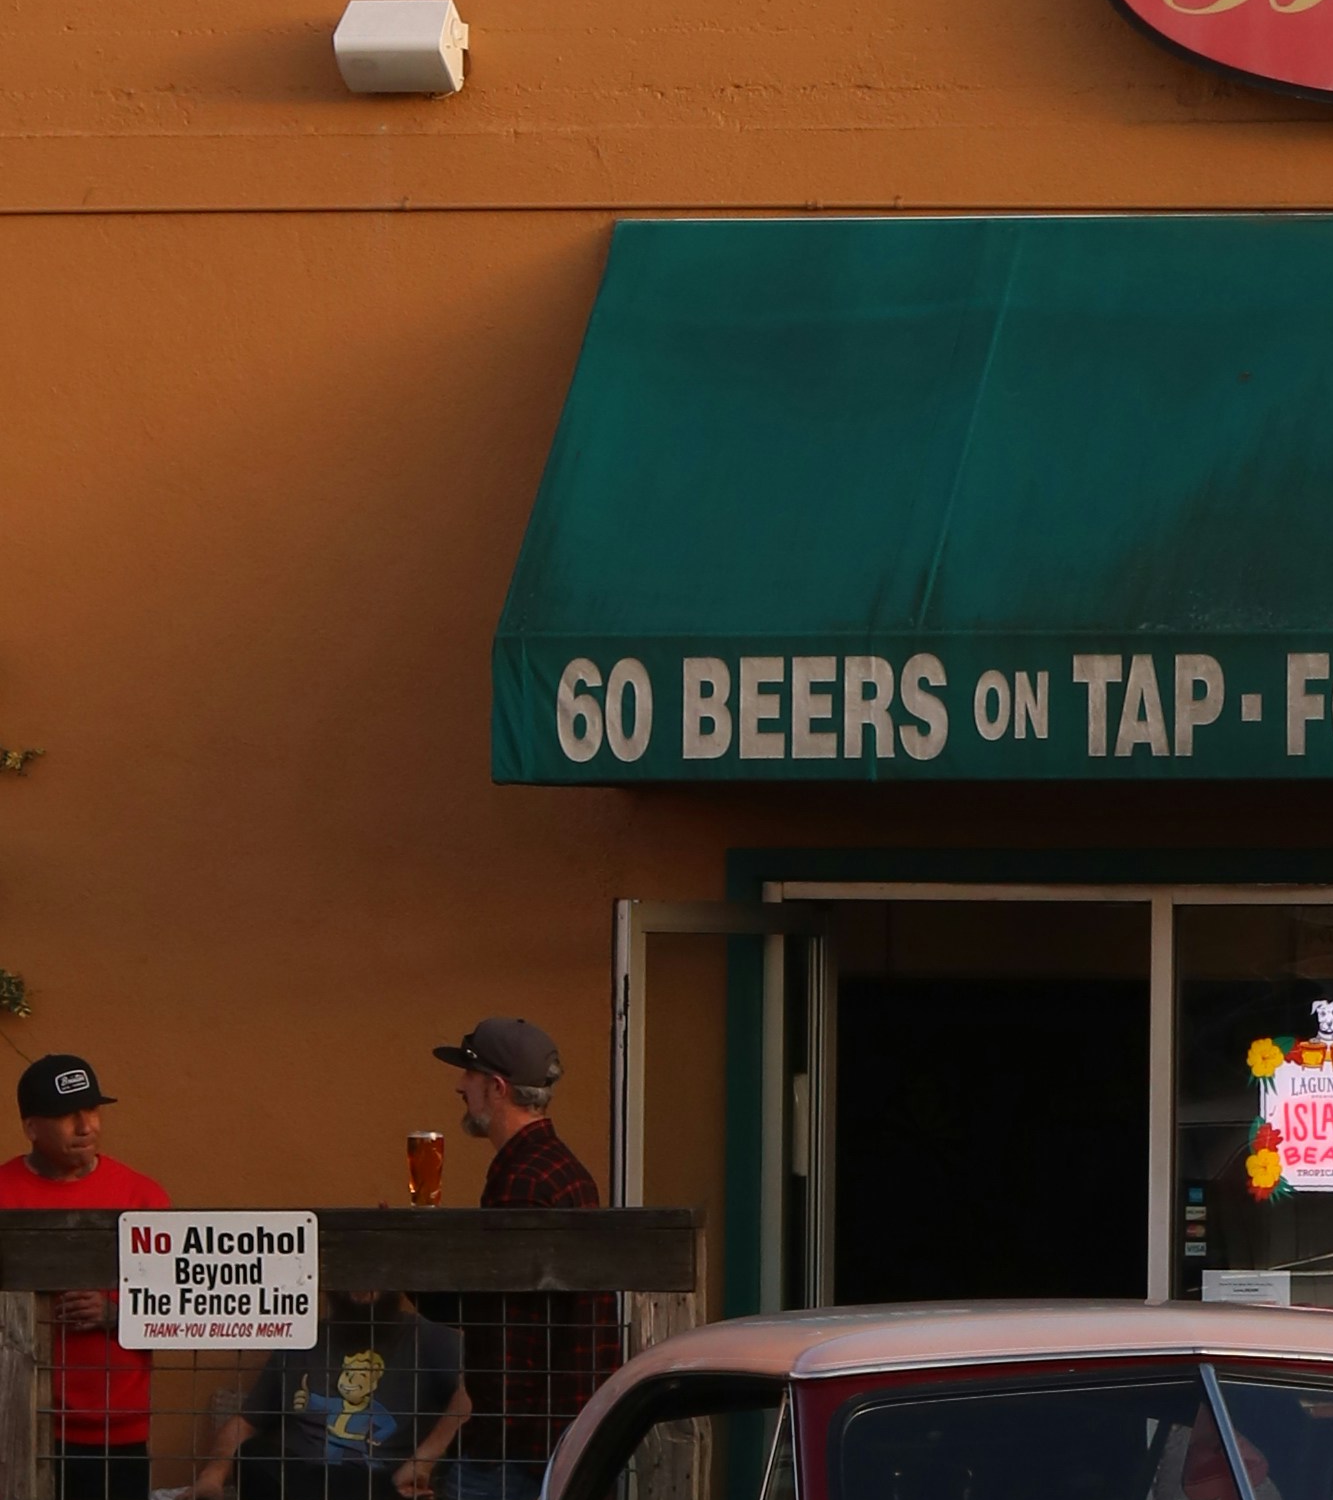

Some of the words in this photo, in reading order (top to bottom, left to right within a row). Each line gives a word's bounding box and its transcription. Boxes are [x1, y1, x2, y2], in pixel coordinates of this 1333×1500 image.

[555, 656, 653, 763] 60
[681, 652, 949, 761] BEERS
[973, 669, 1049, 742] ON
[1072, 653, 1225, 757] TAP
[131, 1226, 171, 1254] No
[182, 1226, 305, 1254] Alcohol
[175, 1257, 262, 1290] Beyond
[129, 1288, 171, 1315] The
[179, 1288, 251, 1315] Fence
[259, 1287, 309, 1315] Line
[144, 1322, 206, 1338] THANK-YOU
[209, 1322, 253, 1338] BILLCOS
[256, 1322, 293, 1338] MGMT.
